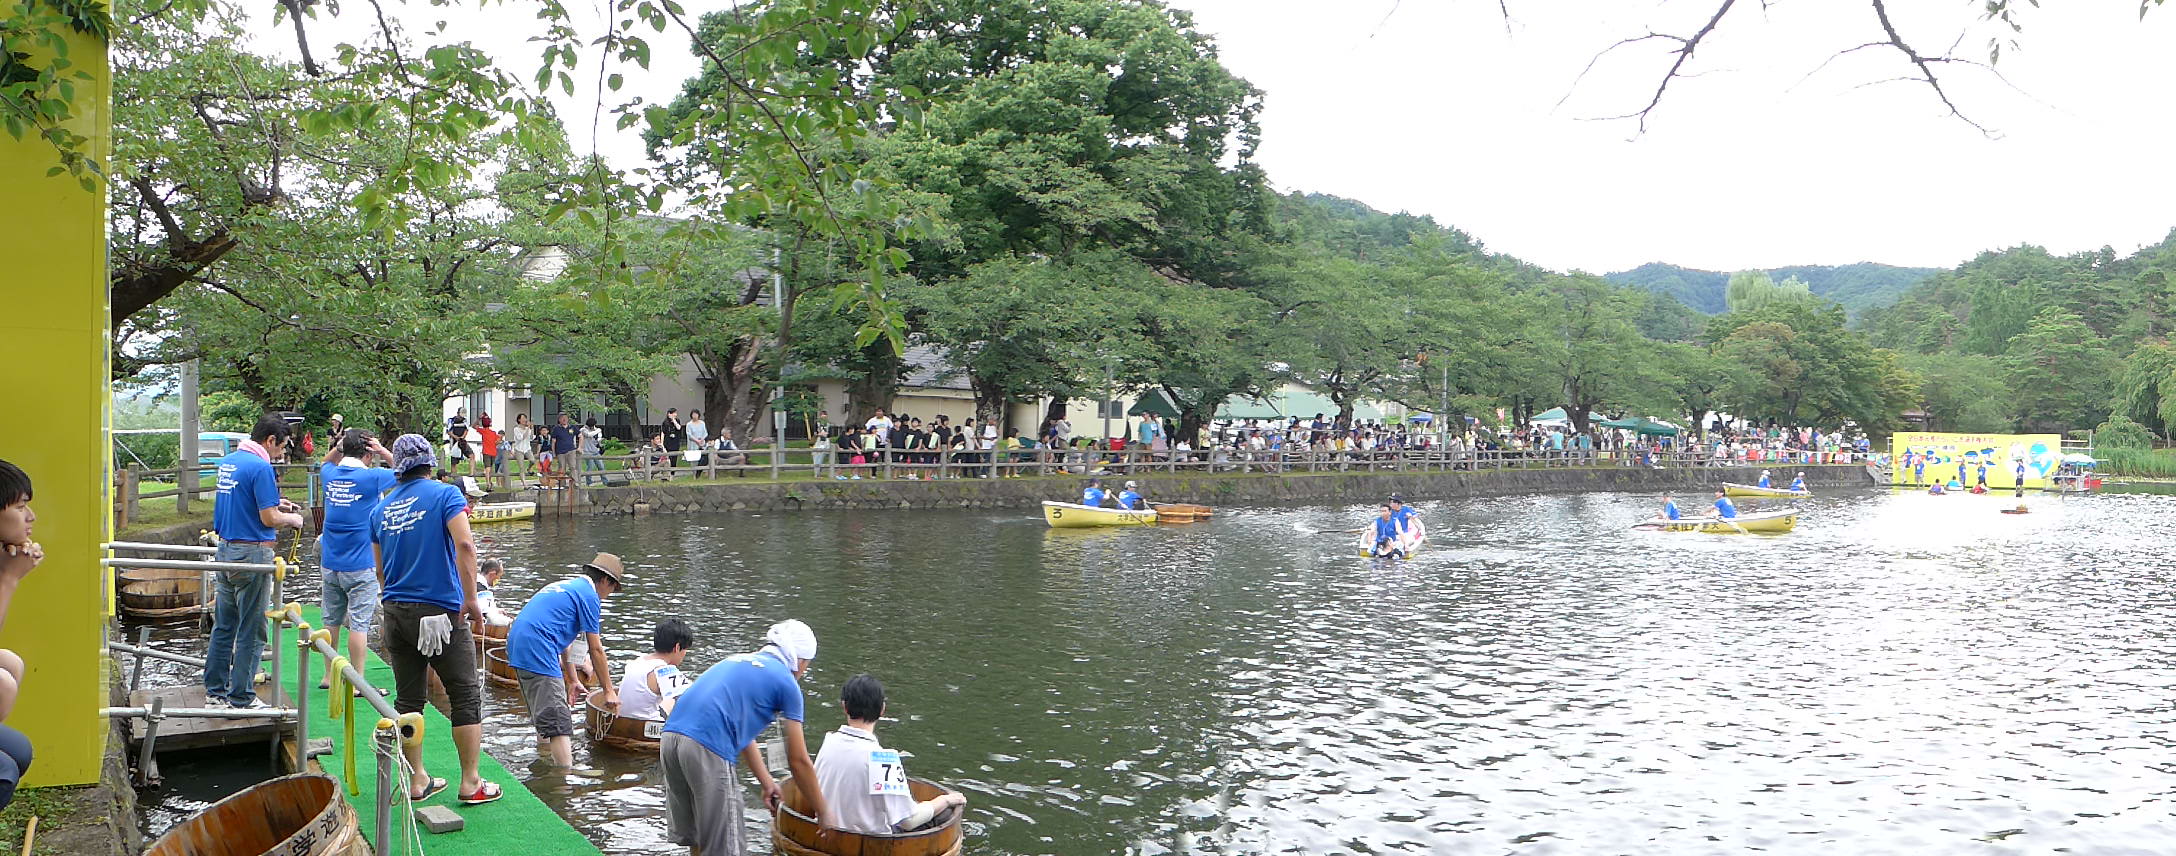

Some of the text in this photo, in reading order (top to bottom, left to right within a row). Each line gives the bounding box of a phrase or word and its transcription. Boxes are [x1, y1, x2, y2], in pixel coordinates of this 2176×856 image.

[1053, 508, 1062, 519] 3
[1784, 516, 1792, 525] 5
[881, 763, 904, 783] 73
